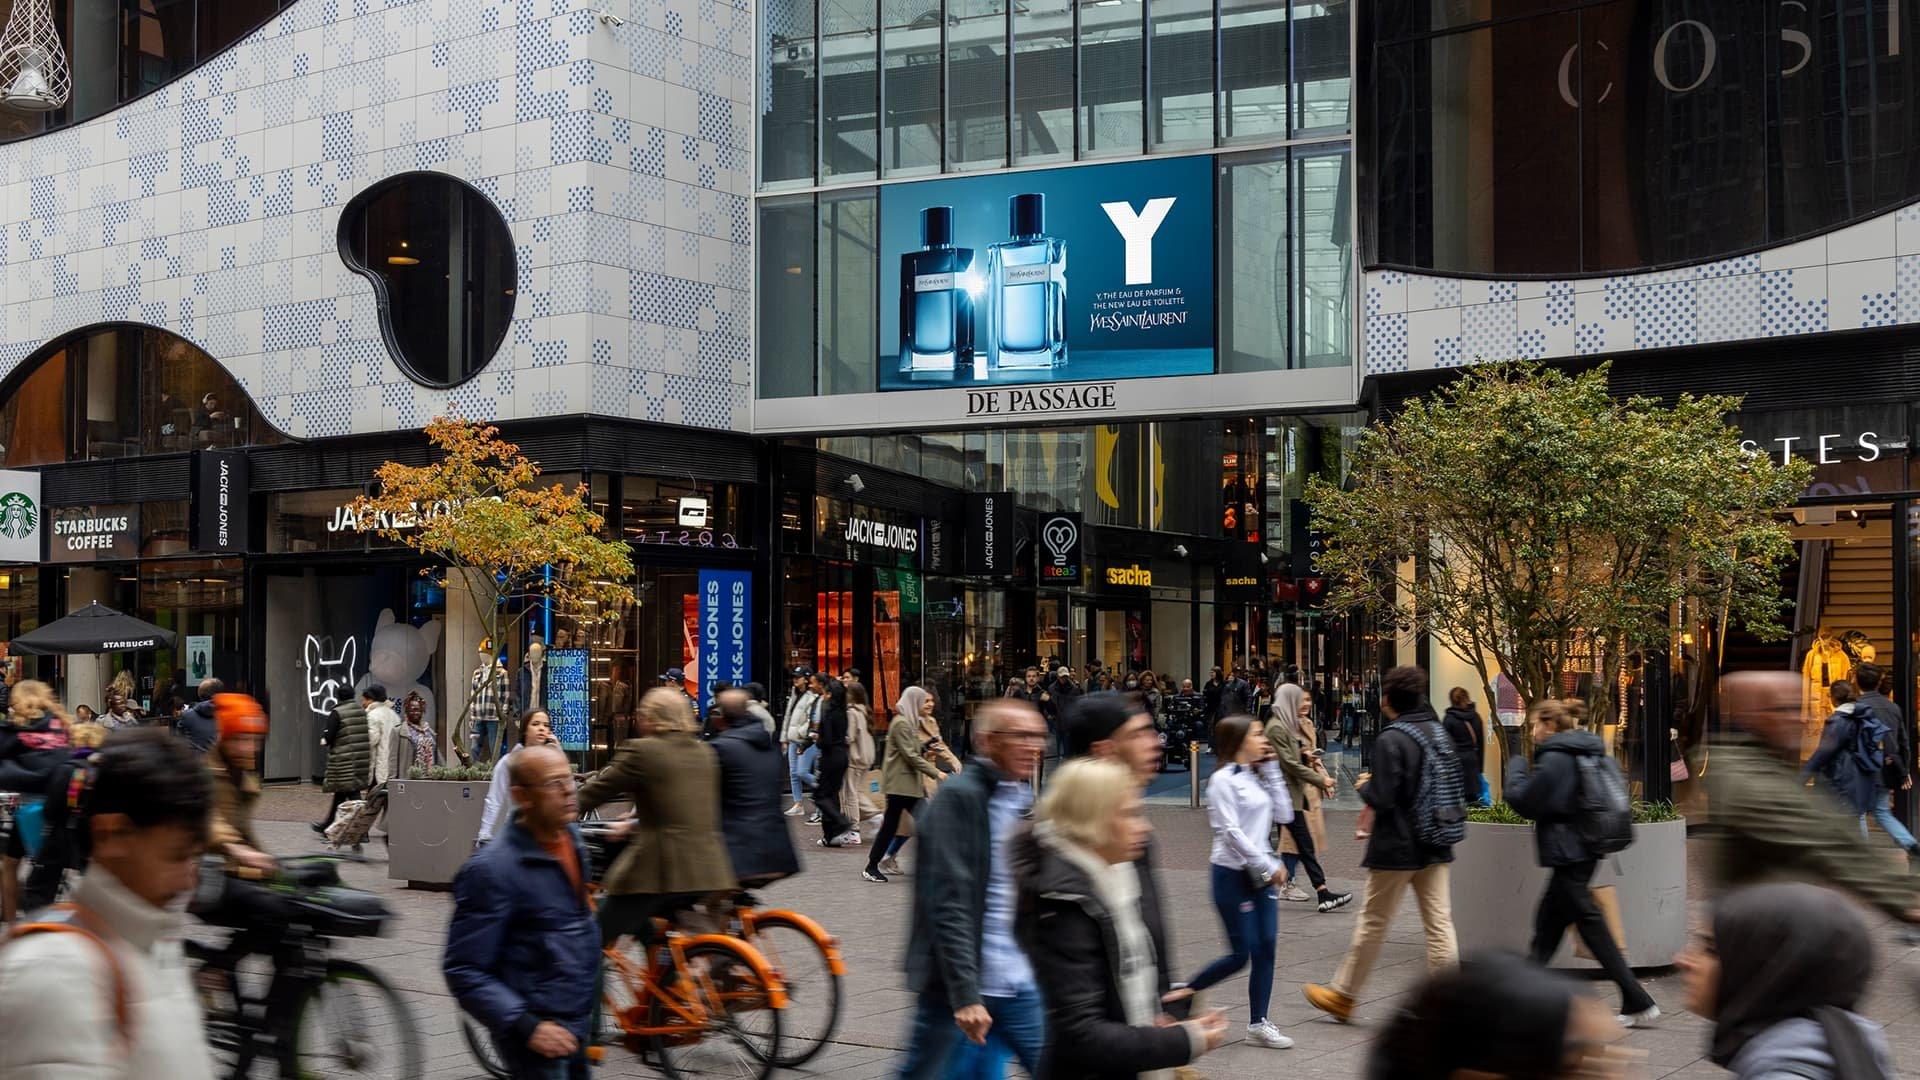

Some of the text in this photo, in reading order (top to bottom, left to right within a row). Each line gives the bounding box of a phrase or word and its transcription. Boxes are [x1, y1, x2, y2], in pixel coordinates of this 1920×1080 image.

[1100, 196, 1177, 286] Y
[1118, 291, 1132, 299] EAU
[1134, 290, 1143, 298] DE
[1145, 288, 1174, 297] PARFUM
[1093, 297, 1185, 310] THE NEW EAU DE TOILETTE
[966, 384, 1117, 415] DE PASSAGE
[54, 516, 128, 535] STARBUCKS
[844, 516, 874, 545] JACK
[884, 524, 918, 552] JONES
[67, 534, 113, 550] COFFEE
[1108, 564, 1151, 586] sacha
[1226, 576, 1257, 585] sacha
[103, 639, 154, 649] STARBUCKS
[706, 580, 719, 708] ACK&JONES
